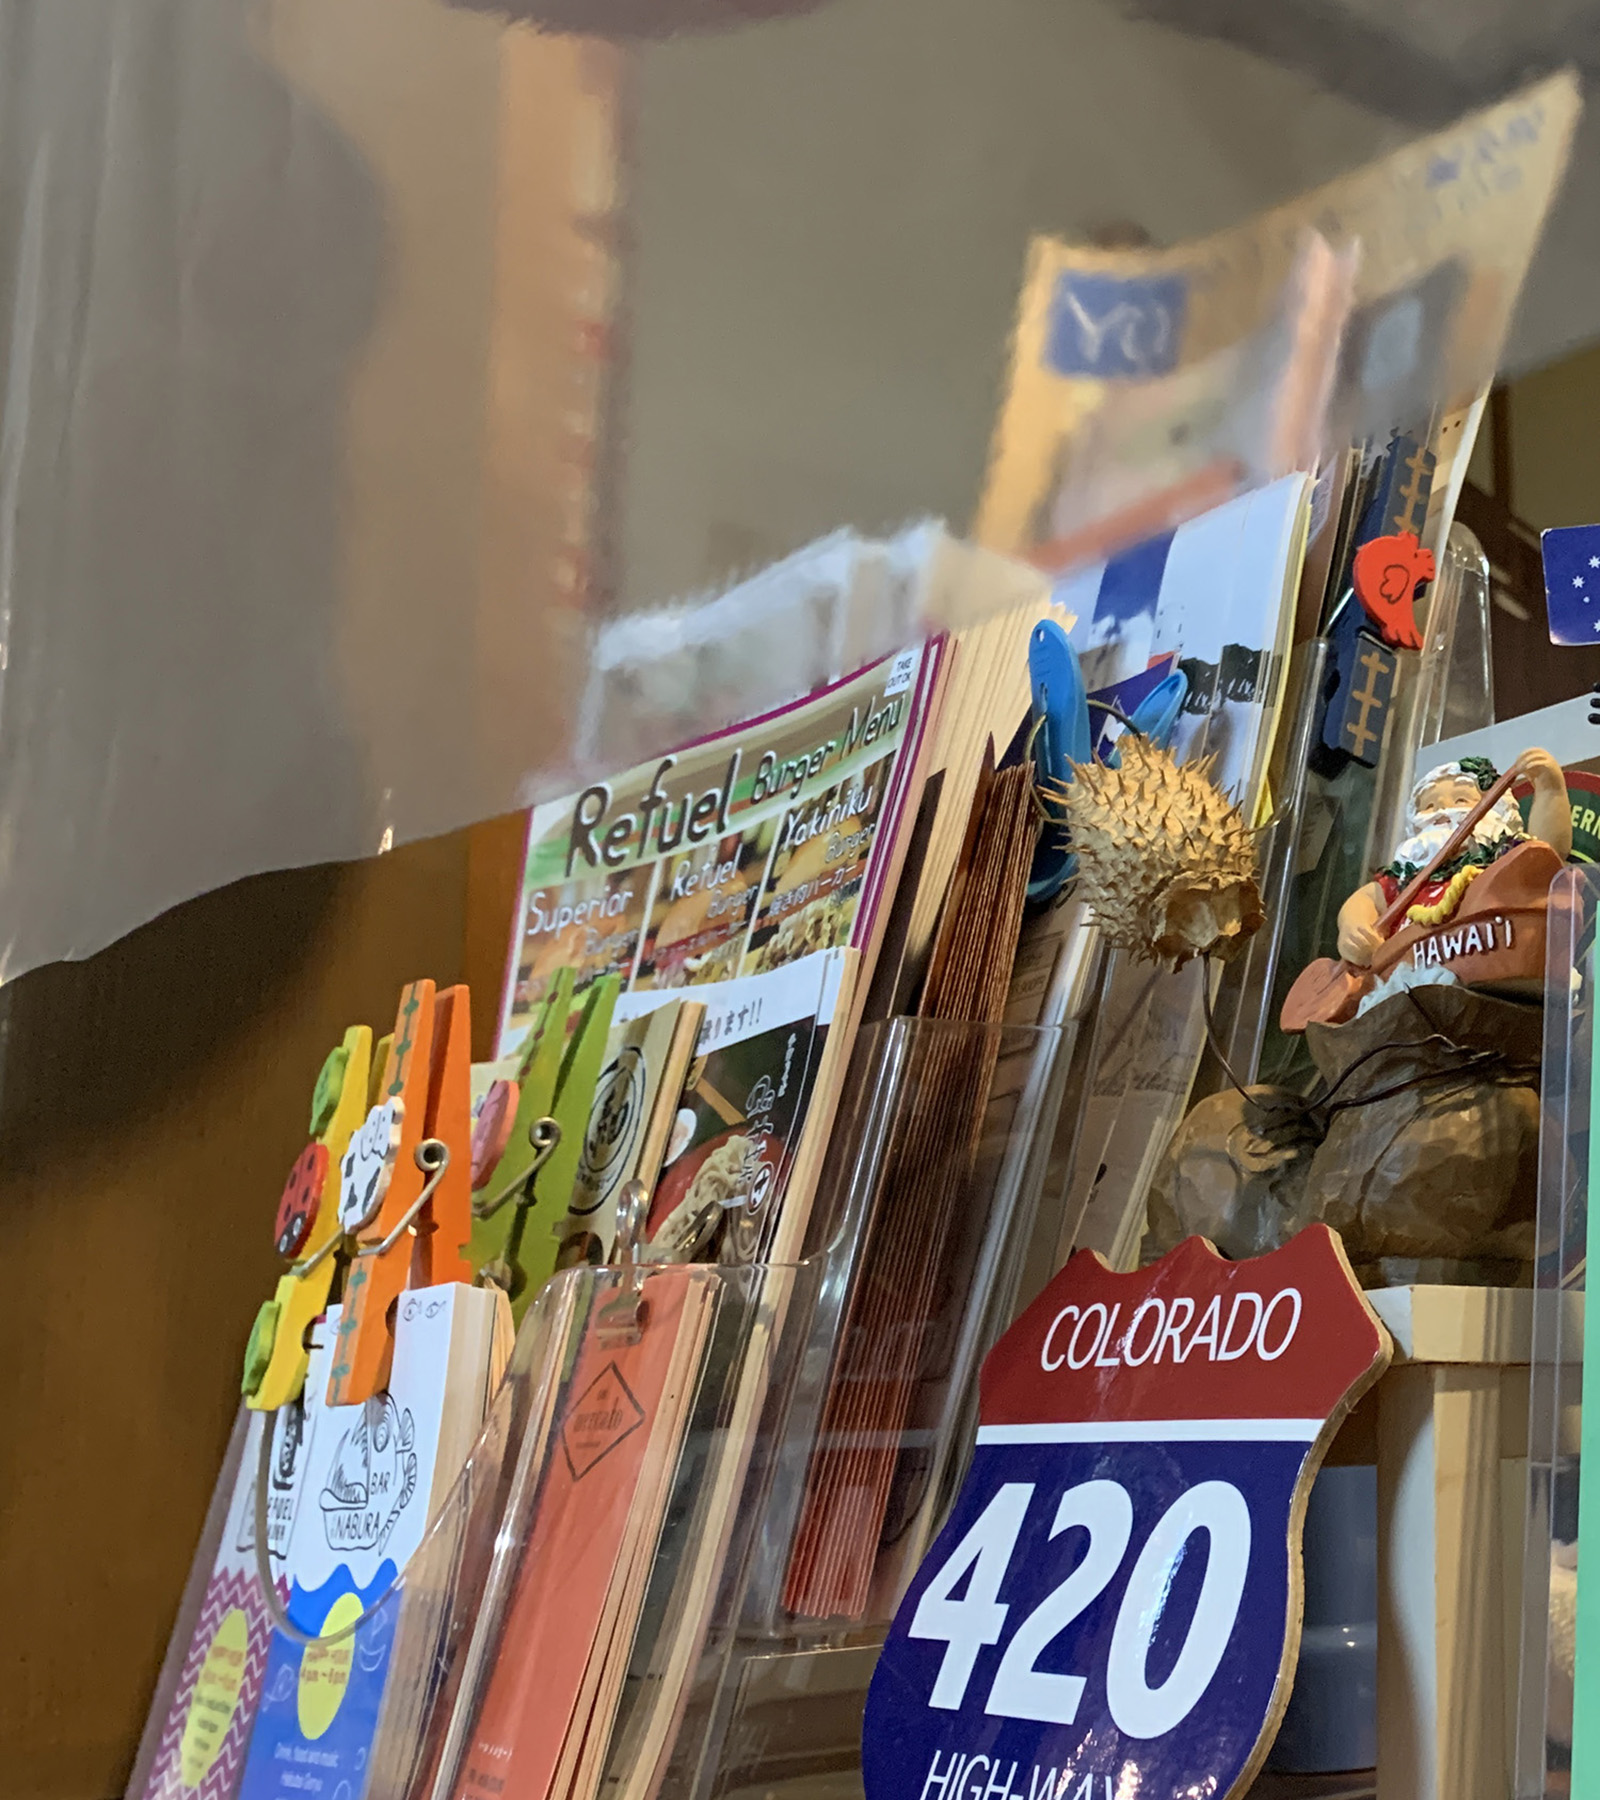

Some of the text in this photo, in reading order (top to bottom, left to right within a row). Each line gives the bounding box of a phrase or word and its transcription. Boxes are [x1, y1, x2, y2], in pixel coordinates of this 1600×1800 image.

[566, 693, 907, 877] Refuel Burger Menu
[785, 785, 872, 852] Yakiniku
[826, 822, 876, 864] Burger
[670, 843, 743, 902] Refuel
[707, 884, 759, 917] Burger
[525, 887, 633, 938] Superior
[1041, 1288, 1302, 1371] COLORADO
[370, 1472, 391, 1496] BAR
[908, 1480, 1251, 1739] 420
